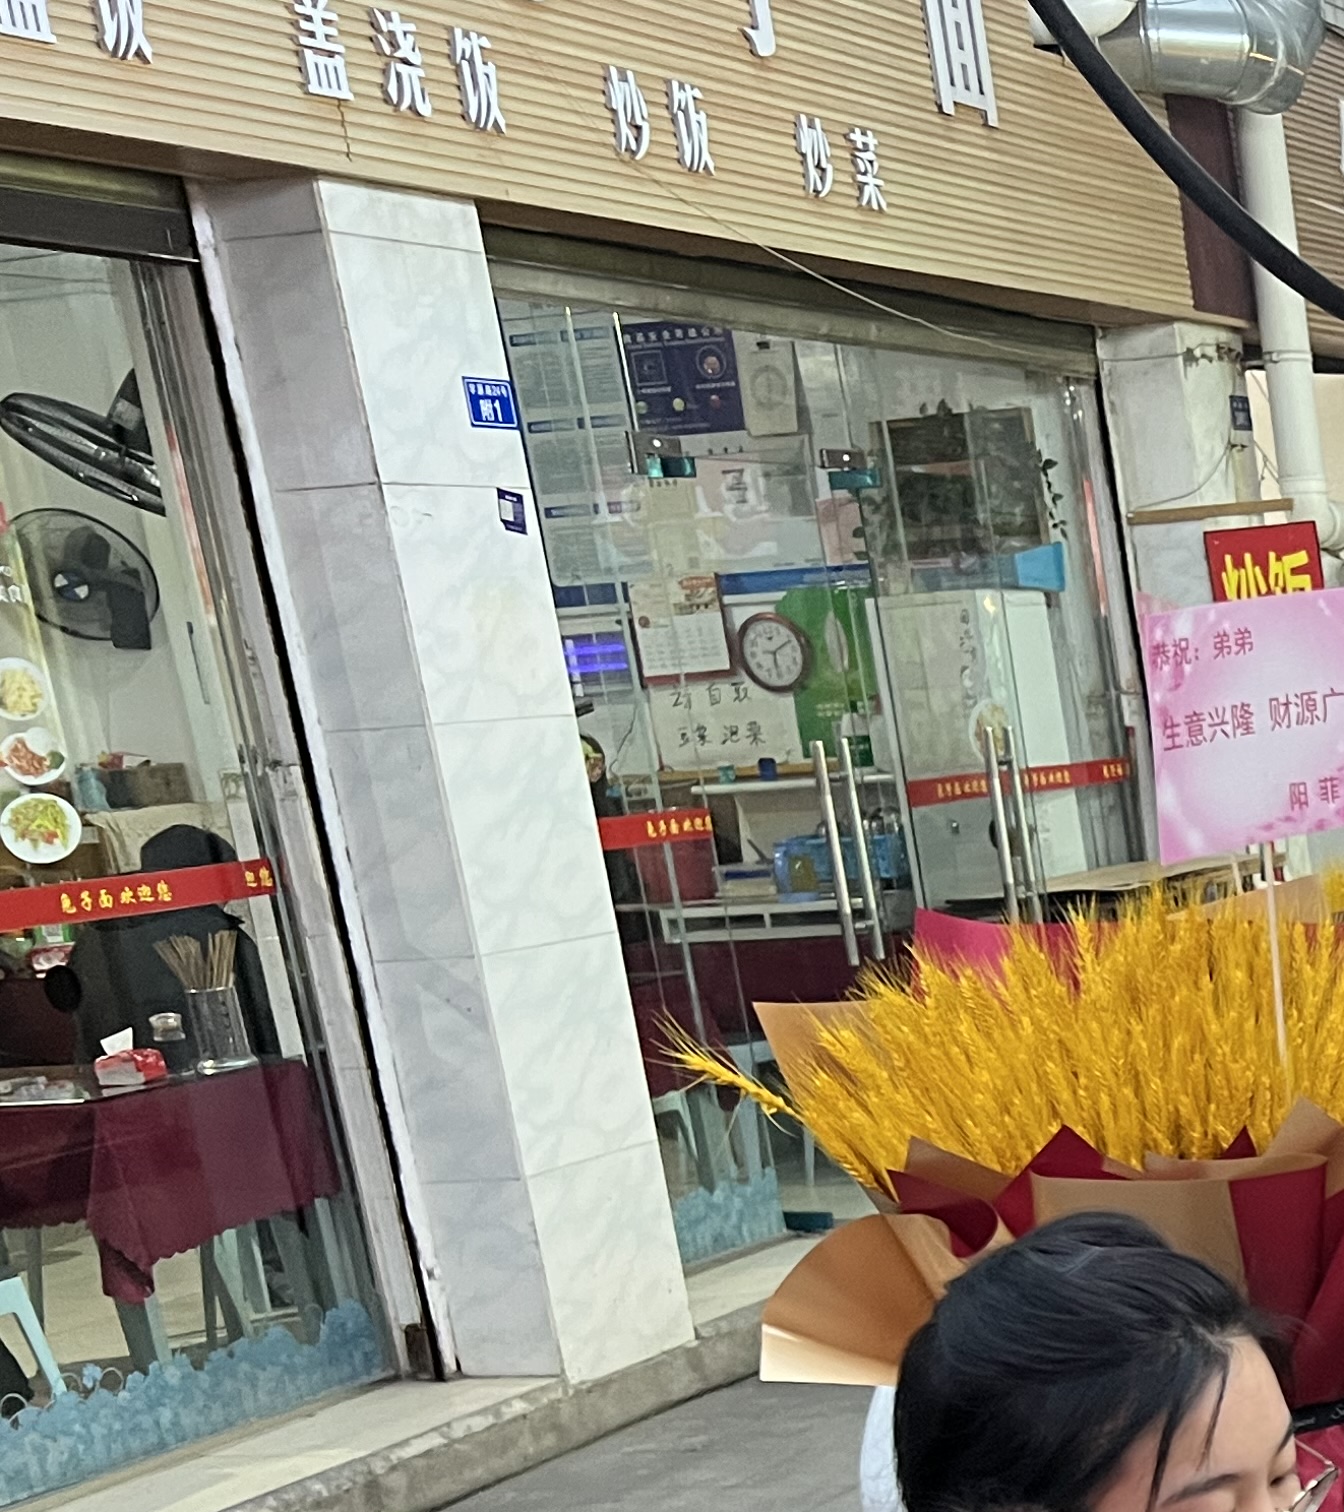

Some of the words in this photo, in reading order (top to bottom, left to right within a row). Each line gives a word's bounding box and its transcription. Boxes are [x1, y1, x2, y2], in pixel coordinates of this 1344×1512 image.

[293, 0, 507, 134] 盖浇饭
[604, 64, 716, 176] 炒饭
[795, 113, 889, 212] 炒菜
[1212, 626, 1255, 660] 弟弟
[1161, 701, 1257, 752] 生意兴隆
